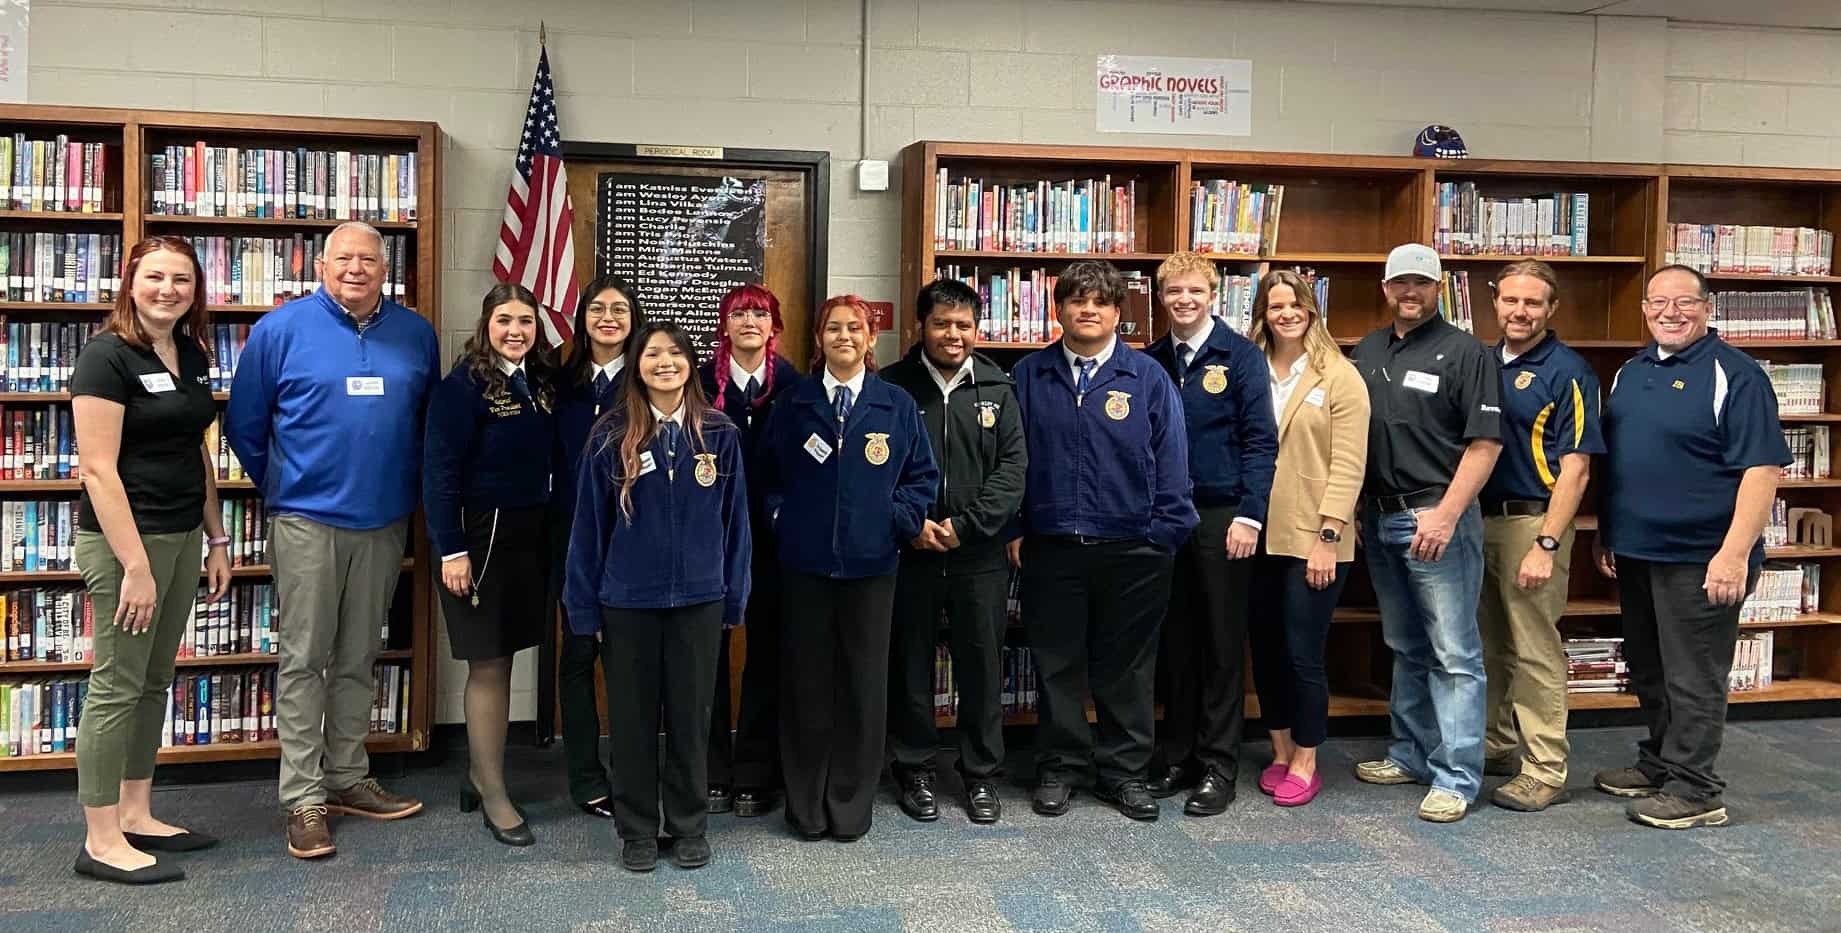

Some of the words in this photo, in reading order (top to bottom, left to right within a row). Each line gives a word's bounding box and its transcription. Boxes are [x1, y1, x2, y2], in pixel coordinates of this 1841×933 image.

[1100, 74, 1162, 92] GRAPHIC
[1167, 77, 1218, 94] NOVELS
[644, 147, 687, 155] PERIODICAL
[640, 184, 687, 192] Katniss
[639, 192, 688, 200] Wesley
[639, 223, 686, 231] Charlie
[677, 240, 736, 248] Hutchins
[638, 254, 700, 262] Augustus
[703, 256, 749, 264] Waters
[659, 271, 718, 279] Kennedy
[638, 285, 678, 293] Logan
[638, 293, 677, 301] Araby
